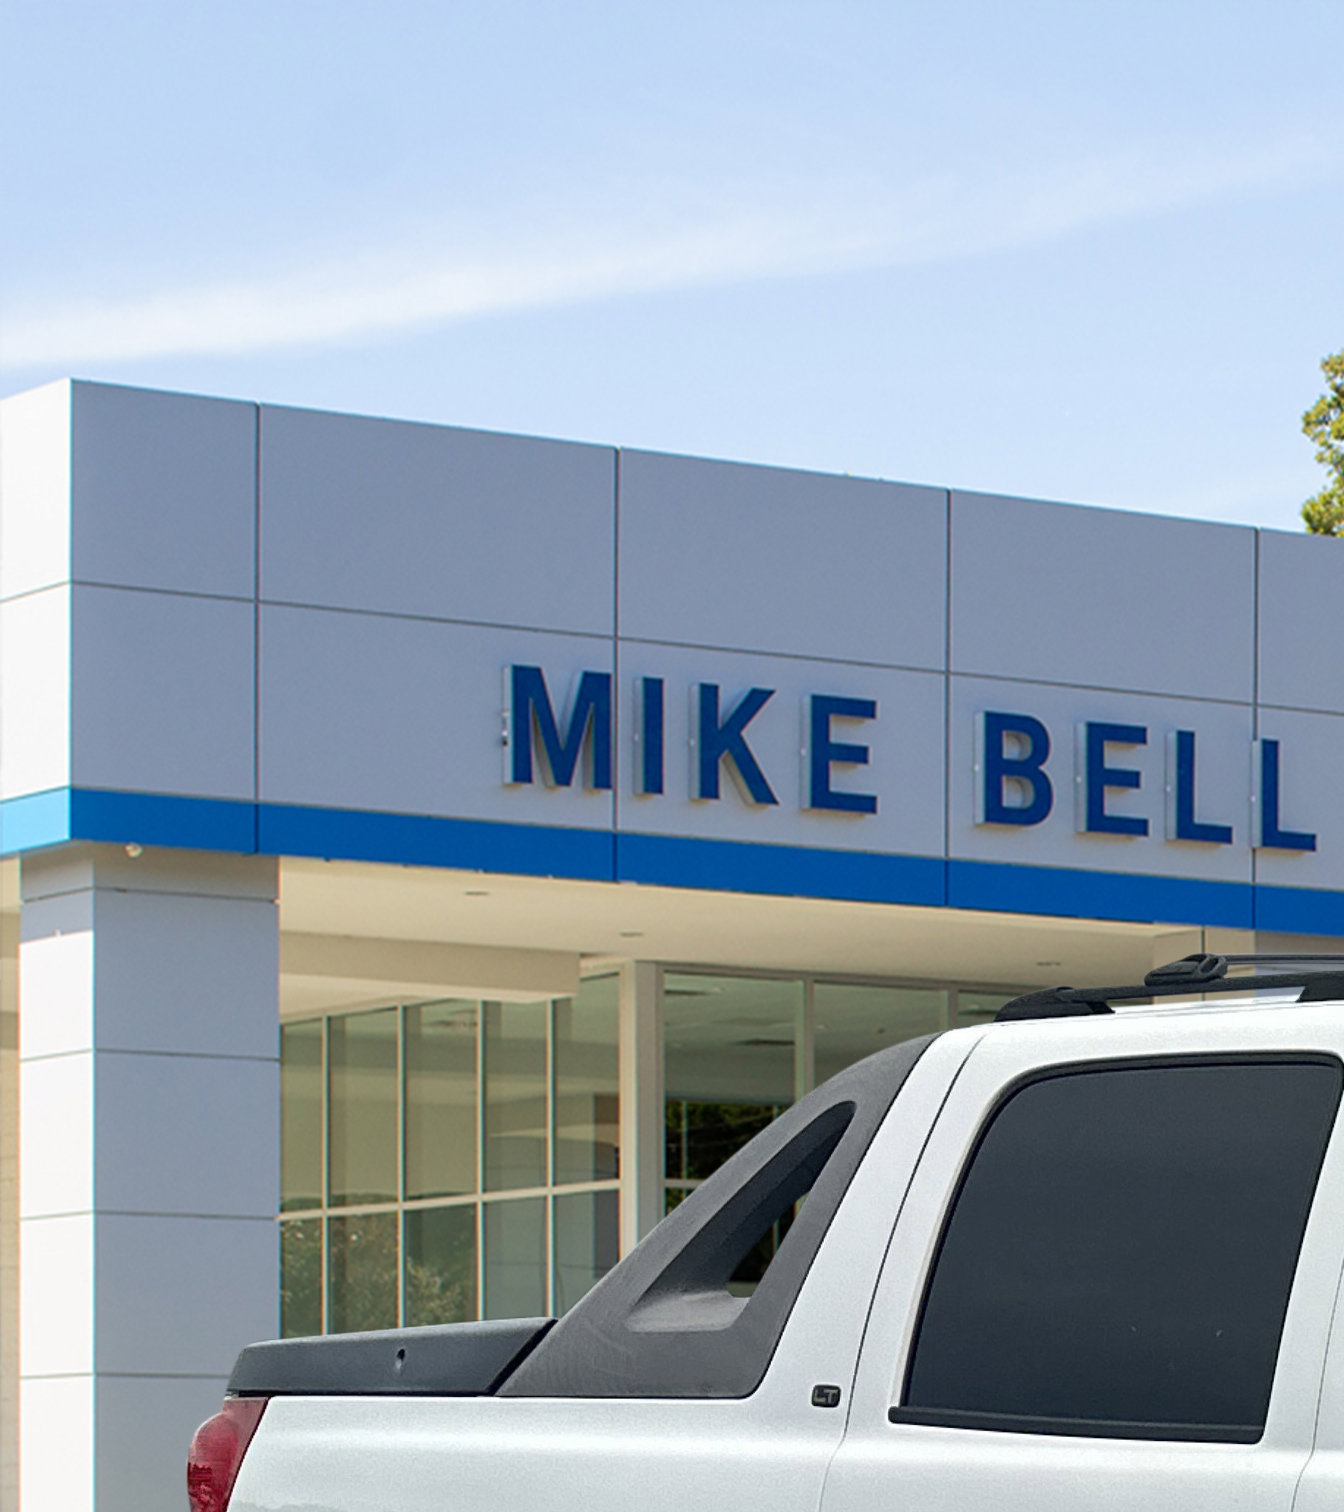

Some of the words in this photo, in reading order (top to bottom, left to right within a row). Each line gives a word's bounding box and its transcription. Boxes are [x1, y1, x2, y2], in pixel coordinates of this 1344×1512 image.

[504, 663, 878, 816] MIKE
[974, 710, 1317, 853] BELL
[813, 1388, 839, 1404] LT
